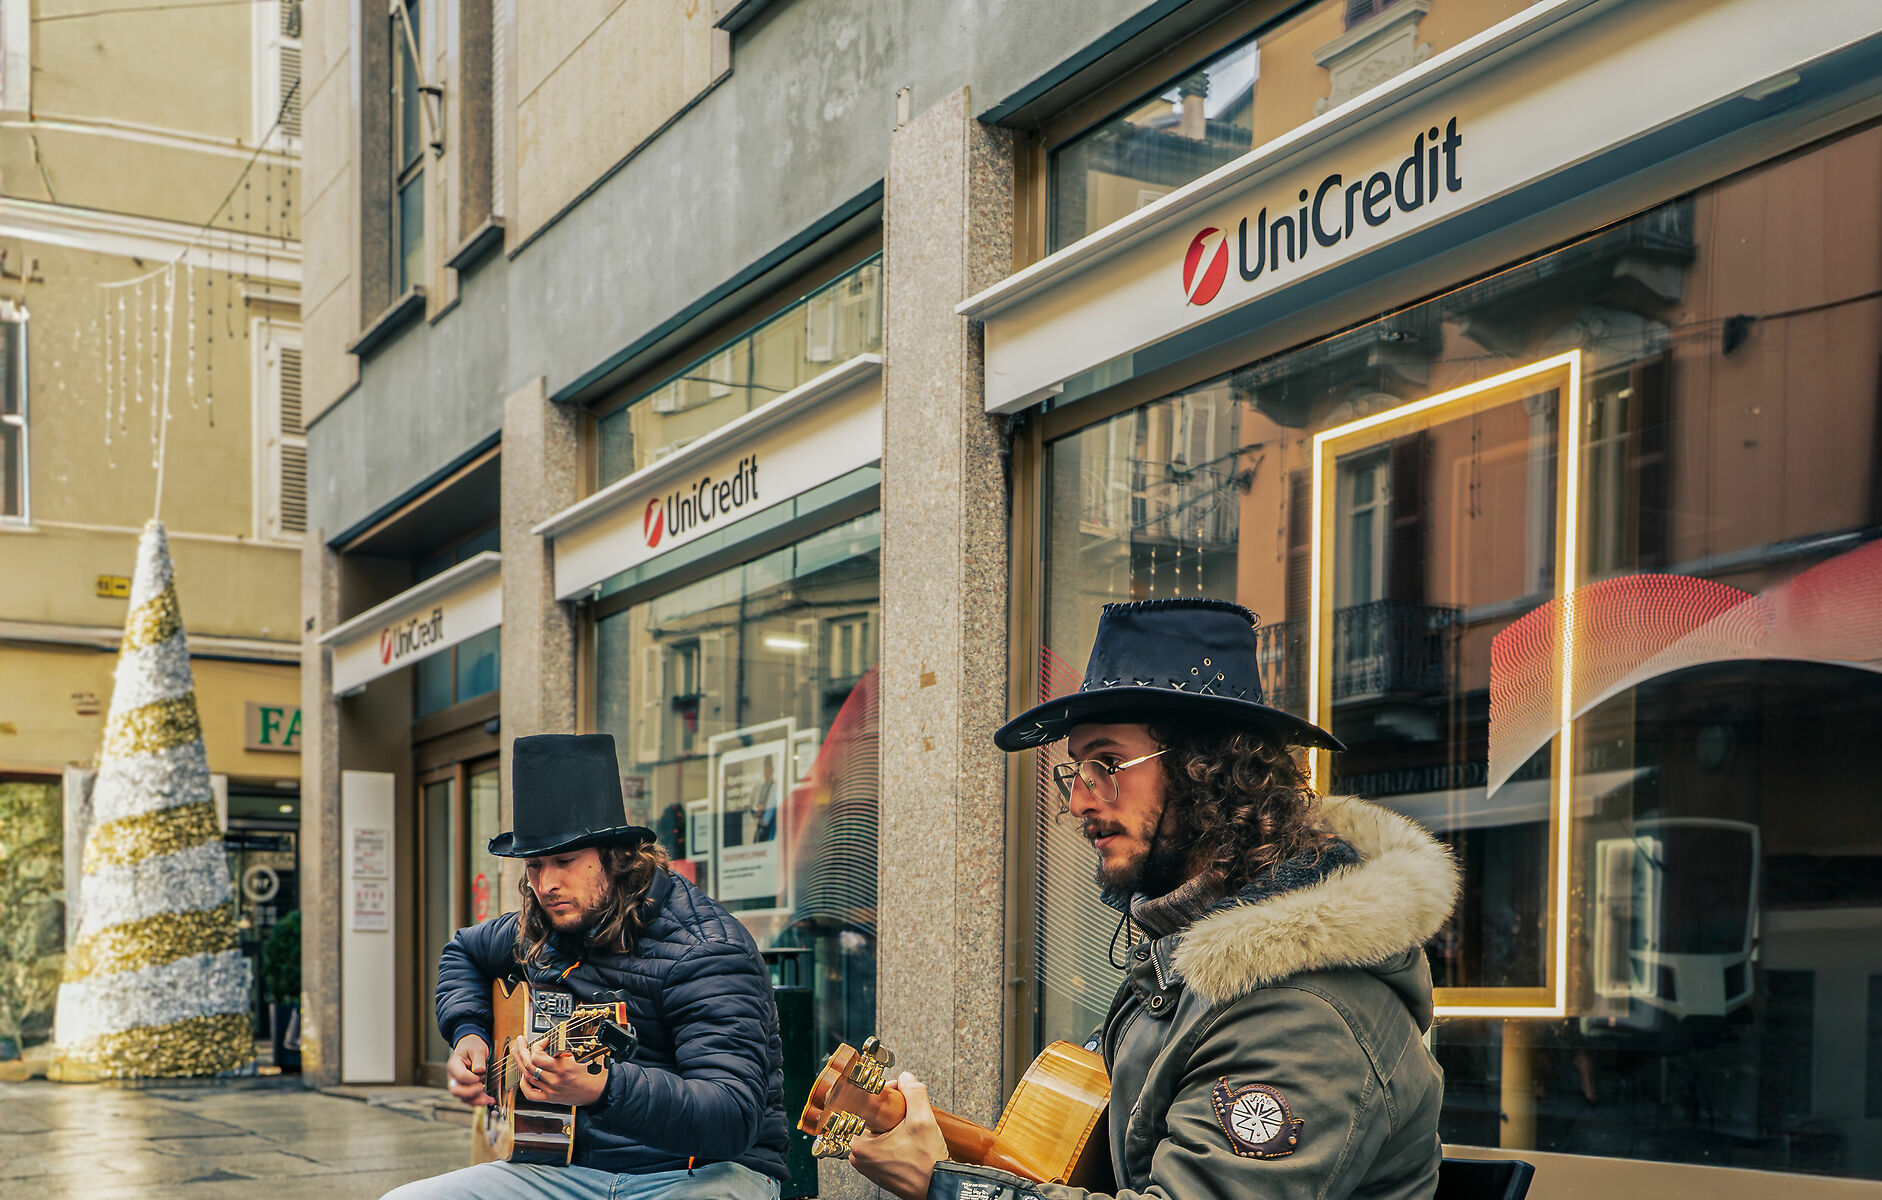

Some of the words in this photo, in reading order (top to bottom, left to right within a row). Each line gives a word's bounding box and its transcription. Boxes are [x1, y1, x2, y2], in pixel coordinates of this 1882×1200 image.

[1238, 116, 1463, 282] UniCredit
[668, 454, 758, 536] UniCredit
[392, 606, 444, 659] UniCredit
